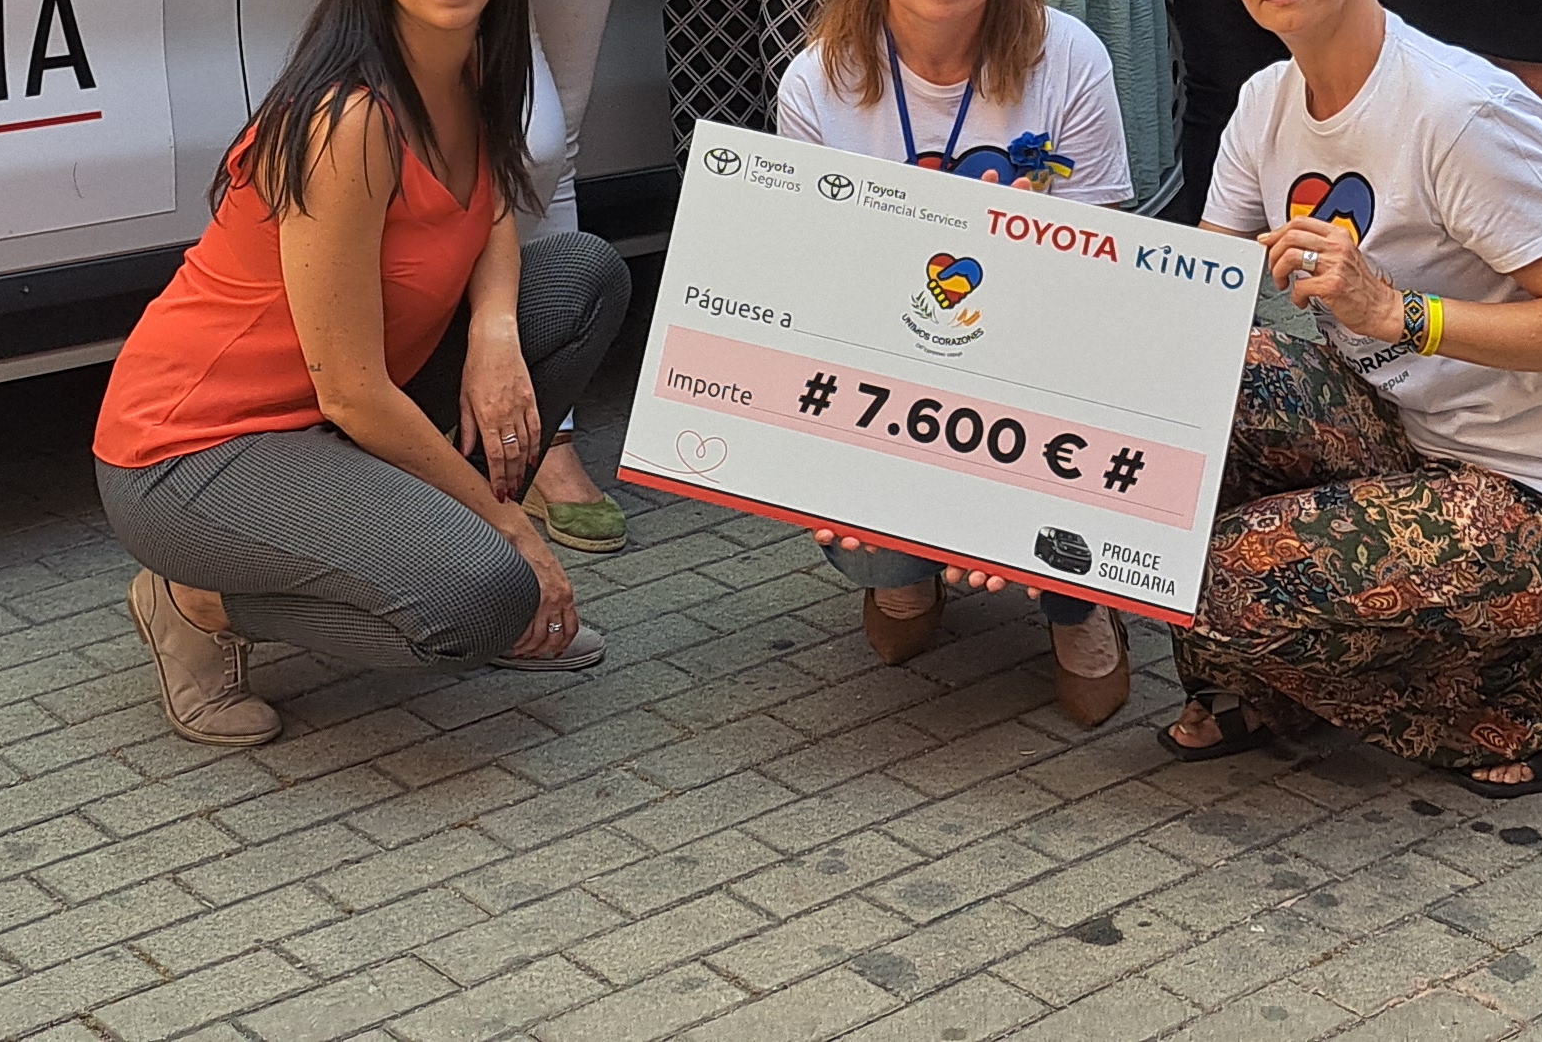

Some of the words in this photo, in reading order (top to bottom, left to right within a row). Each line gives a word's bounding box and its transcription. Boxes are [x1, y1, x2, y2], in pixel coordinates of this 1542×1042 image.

[750, 170, 801, 193] Seguros
[754, 155, 795, 176] Toyota
[866, 180, 907, 201] Toyota
[862, 195, 917, 219] Financial
[918, 208, 969, 230] Services
[987, 208, 1118, 262] TOYOTA
[684, 286, 775, 325] Páguese
[779, 312, 792, 328] a
[667, 367, 753, 406] Importe
[855, 382, 1026, 464] 7.600
[1042, 433, 1089, 480] €
[1101, 542, 1162, 571] PROACE
[1098, 562, 1176, 596] SOLIDARIA
